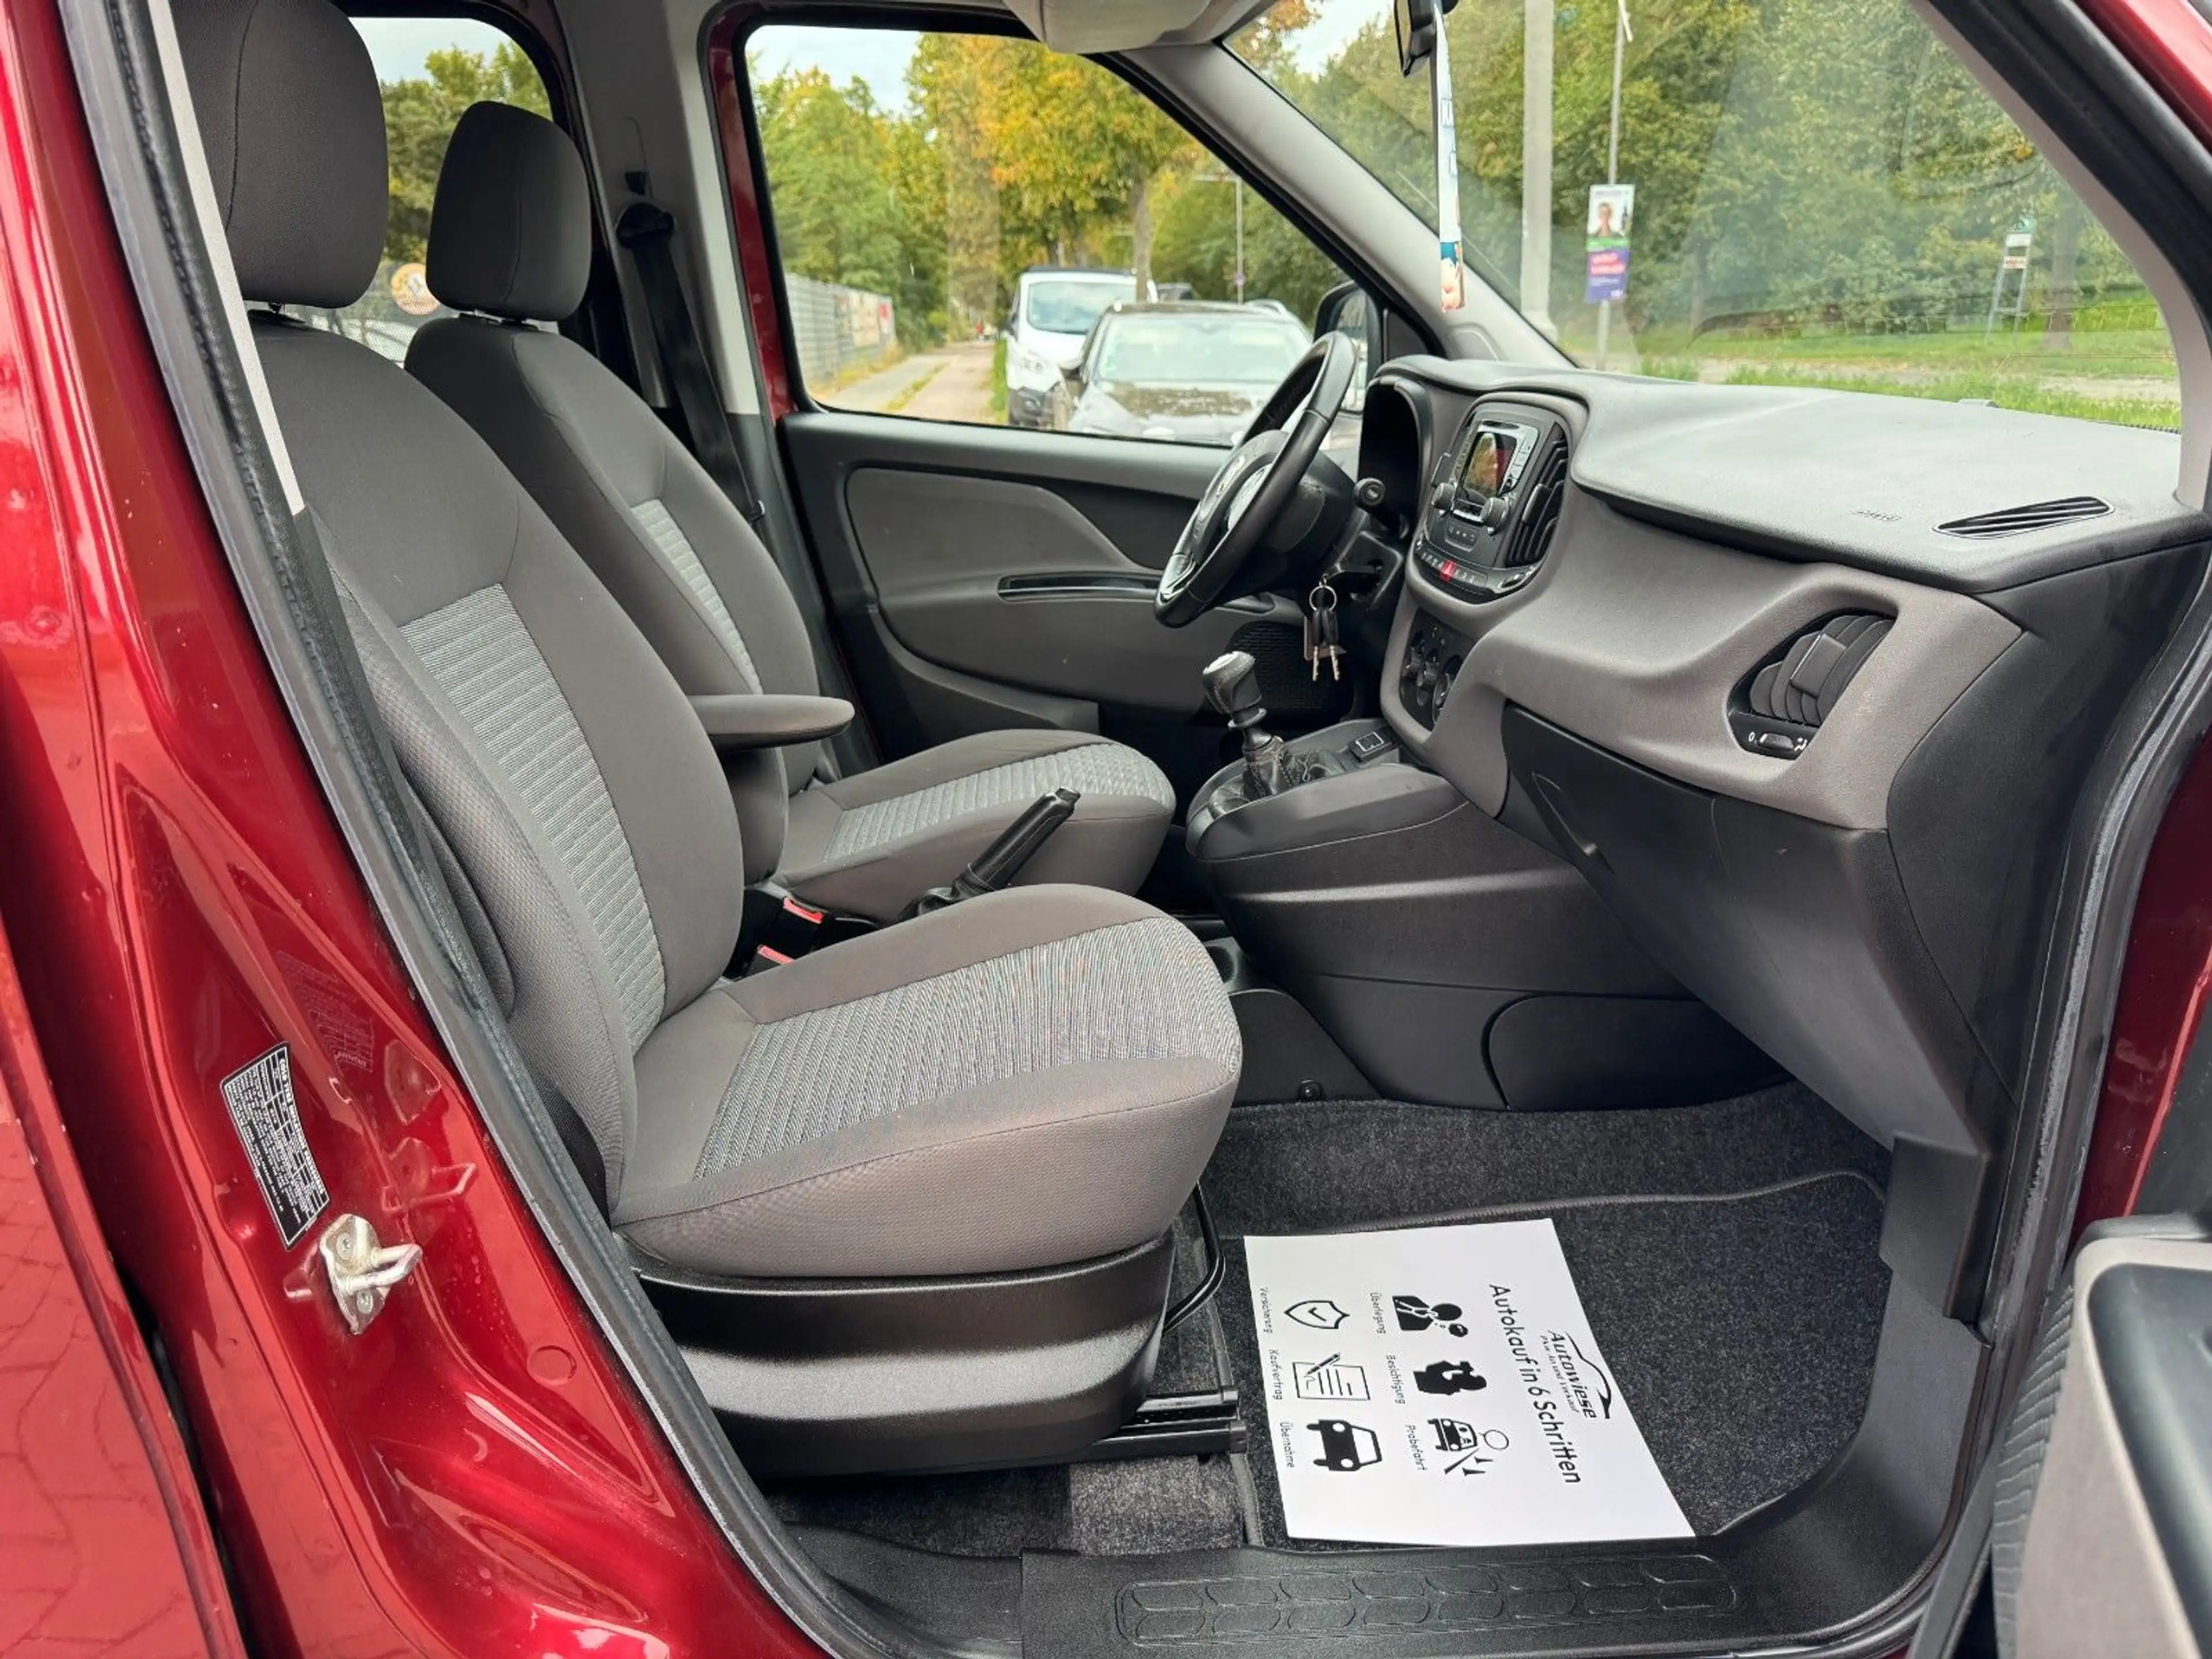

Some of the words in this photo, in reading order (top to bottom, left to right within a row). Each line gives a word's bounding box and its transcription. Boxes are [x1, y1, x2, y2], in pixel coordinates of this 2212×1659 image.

[1260, 1287, 1272, 1334] Versicherung
[1370, 1292, 1386, 1334] Überlegung
[1488, 1283, 1538, 1365] Autokauf
[1269, 1349, 1283, 1400] Kaufvertrag
[1386, 1354, 1406, 1404] Besichtigung
[1519, 1368, 1541, 1382] in
[1528, 1386, 1551, 1396] 6
[1548, 1330, 1597, 1418] Autowiese
[1279, 1421, 1295, 1468] Übernahme
[1405, 1423, 1427, 1471] Probefahrt
[1533, 1400, 1581, 1483] Schritten
